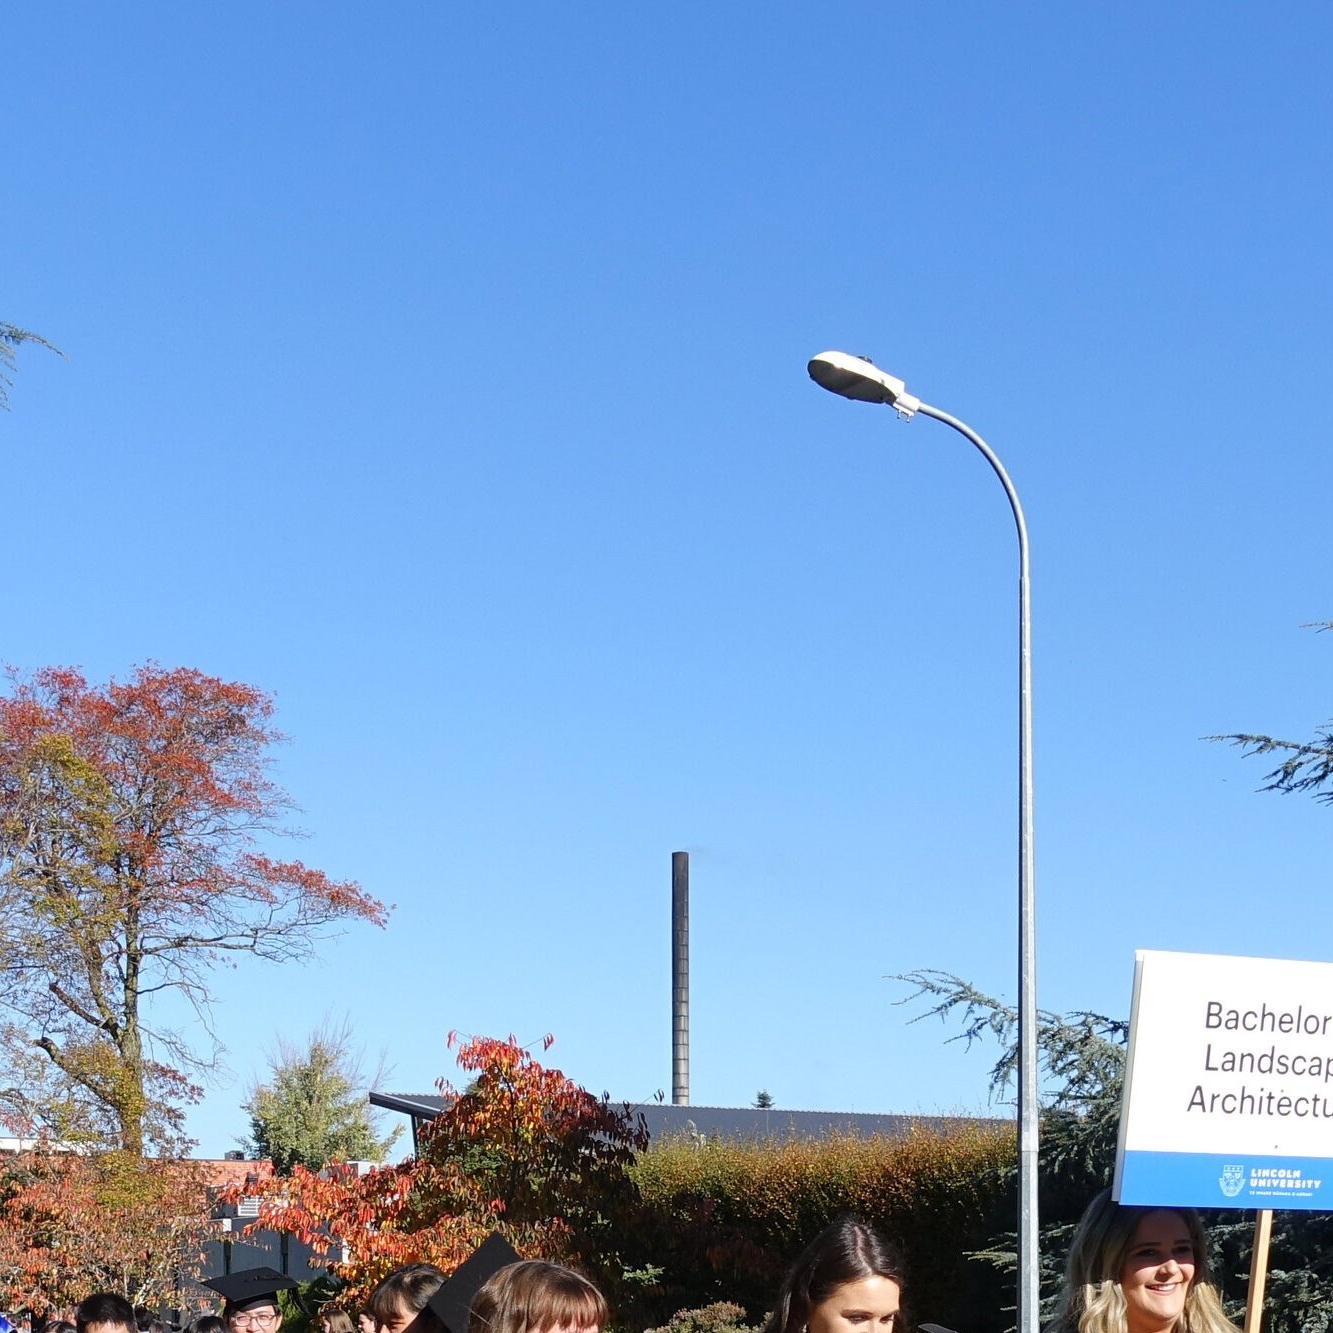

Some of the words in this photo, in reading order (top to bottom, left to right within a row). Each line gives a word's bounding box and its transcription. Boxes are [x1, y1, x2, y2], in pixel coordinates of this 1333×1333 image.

[1205, 1001, 1332, 1035] Bachelor
[1251, 1168, 1301, 1178] LINCOLN
[1249, 1178, 1321, 1189] UNIVERSITY
